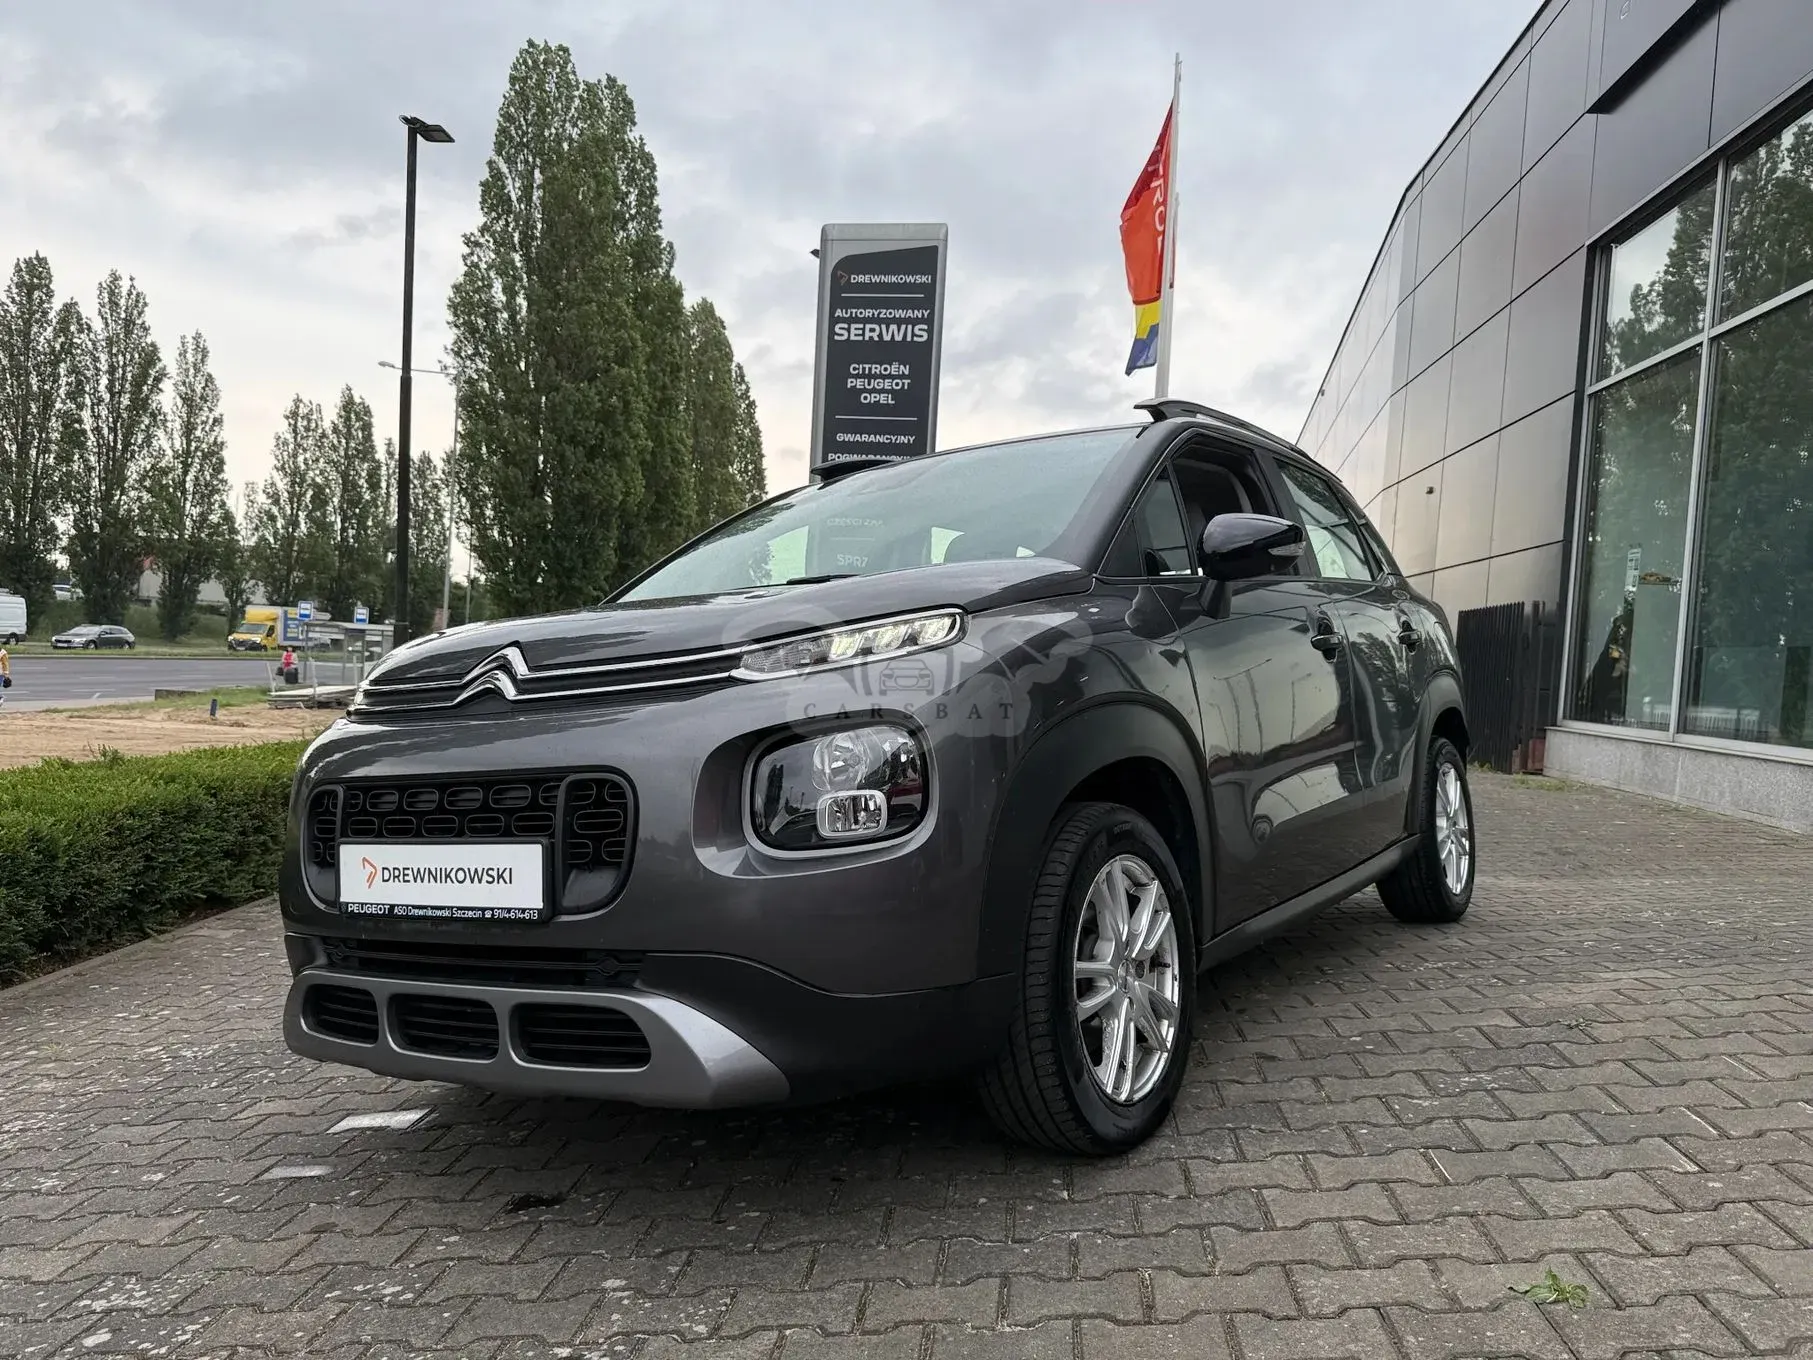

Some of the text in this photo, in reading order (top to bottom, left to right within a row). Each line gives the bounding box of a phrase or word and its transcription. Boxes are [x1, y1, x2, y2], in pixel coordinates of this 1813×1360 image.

[850, 274, 931, 284] DREWNIKOWSKI
[834, 308, 930, 319] AUTORYZOWANY
[833, 323, 929, 342] SERWIS
[849, 362, 909, 375] CITROËN
[847, 378, 911, 390] PEUGEOT
[860, 393, 895, 404] OPEL
[836, 433, 916, 444] GWARANCYJNY
[381, 867, 513, 885] DREWNIKOWSKI
[348, 903, 390, 914] PEUGEOT
[394, 905, 407, 915] ASO
[408, 906, 451, 917] Drewnikowski
[452, 907, 482, 918] Szczecin
